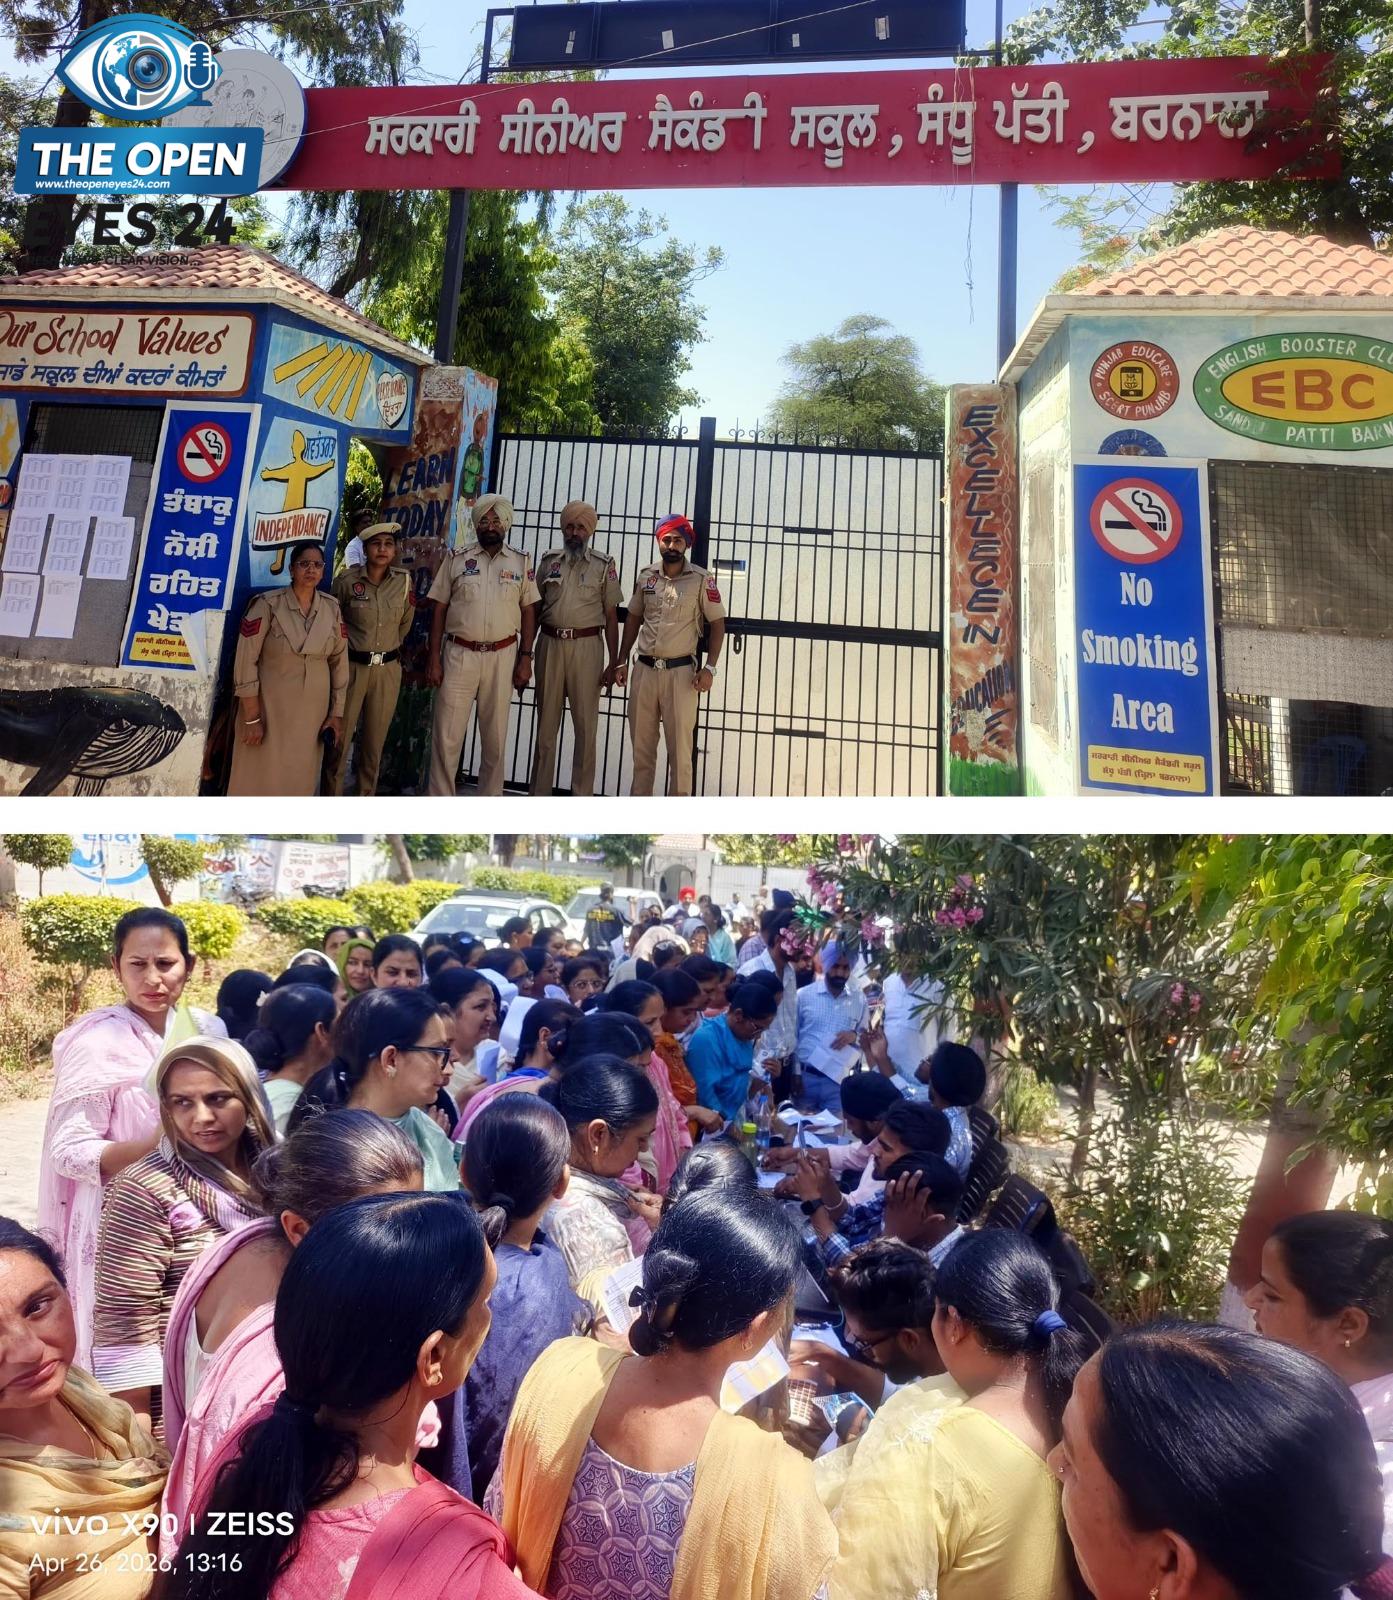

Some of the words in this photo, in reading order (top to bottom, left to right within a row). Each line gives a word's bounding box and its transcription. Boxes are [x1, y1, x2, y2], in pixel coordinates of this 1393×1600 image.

[365, 99, 481, 156] ਸਰਕਾਰੀ
[499, 97, 628, 155] ਸੀਨੀਅਰ
[917, 82, 977, 166] ਸੰਧੂ
[1109, 90, 1270, 142] ਬਰਨਾਲਾ
[33, 314, 124, 357] School
[138, 316, 230, 356] Values
[31, 365, 79, 387] ਸਕੂਲ
[82, 360, 124, 384] ਦੀਆਂ
[125, 363, 175, 386] ਕਦਰਾਂ
[175, 361, 228, 388] ਕੀਮਤਾਂ
[1094, 348, 1124, 380] PUNJAB
[1131, 345, 1173, 377] EDUCARE
[1207, 342, 1267, 379] ENGLISH
[1280, 338, 1357, 356] BOOSTER
[1135, 390, 1171, 417] PUNJAB
[1251, 368, 1376, 411] EBC
[1285, 426, 1335, 443] PATTI
[384, 447, 455, 499] LEARN
[163, 488, 234, 525] ਤੰਬਾਕੂ
[163, 529, 220, 560] ਨੋਸ਼ੀ
[255, 513, 326, 542] INDEPENDANCE
[149, 569, 222, 597] ਰਹਿਤ
[1120, 572, 1153, 607] No
[147, 603, 187, 632] ਖੇਤ
[962, 623, 1001, 645] IN
[1082, 629, 1199, 677] Smoking
[1111, 693, 1175, 734] Area
